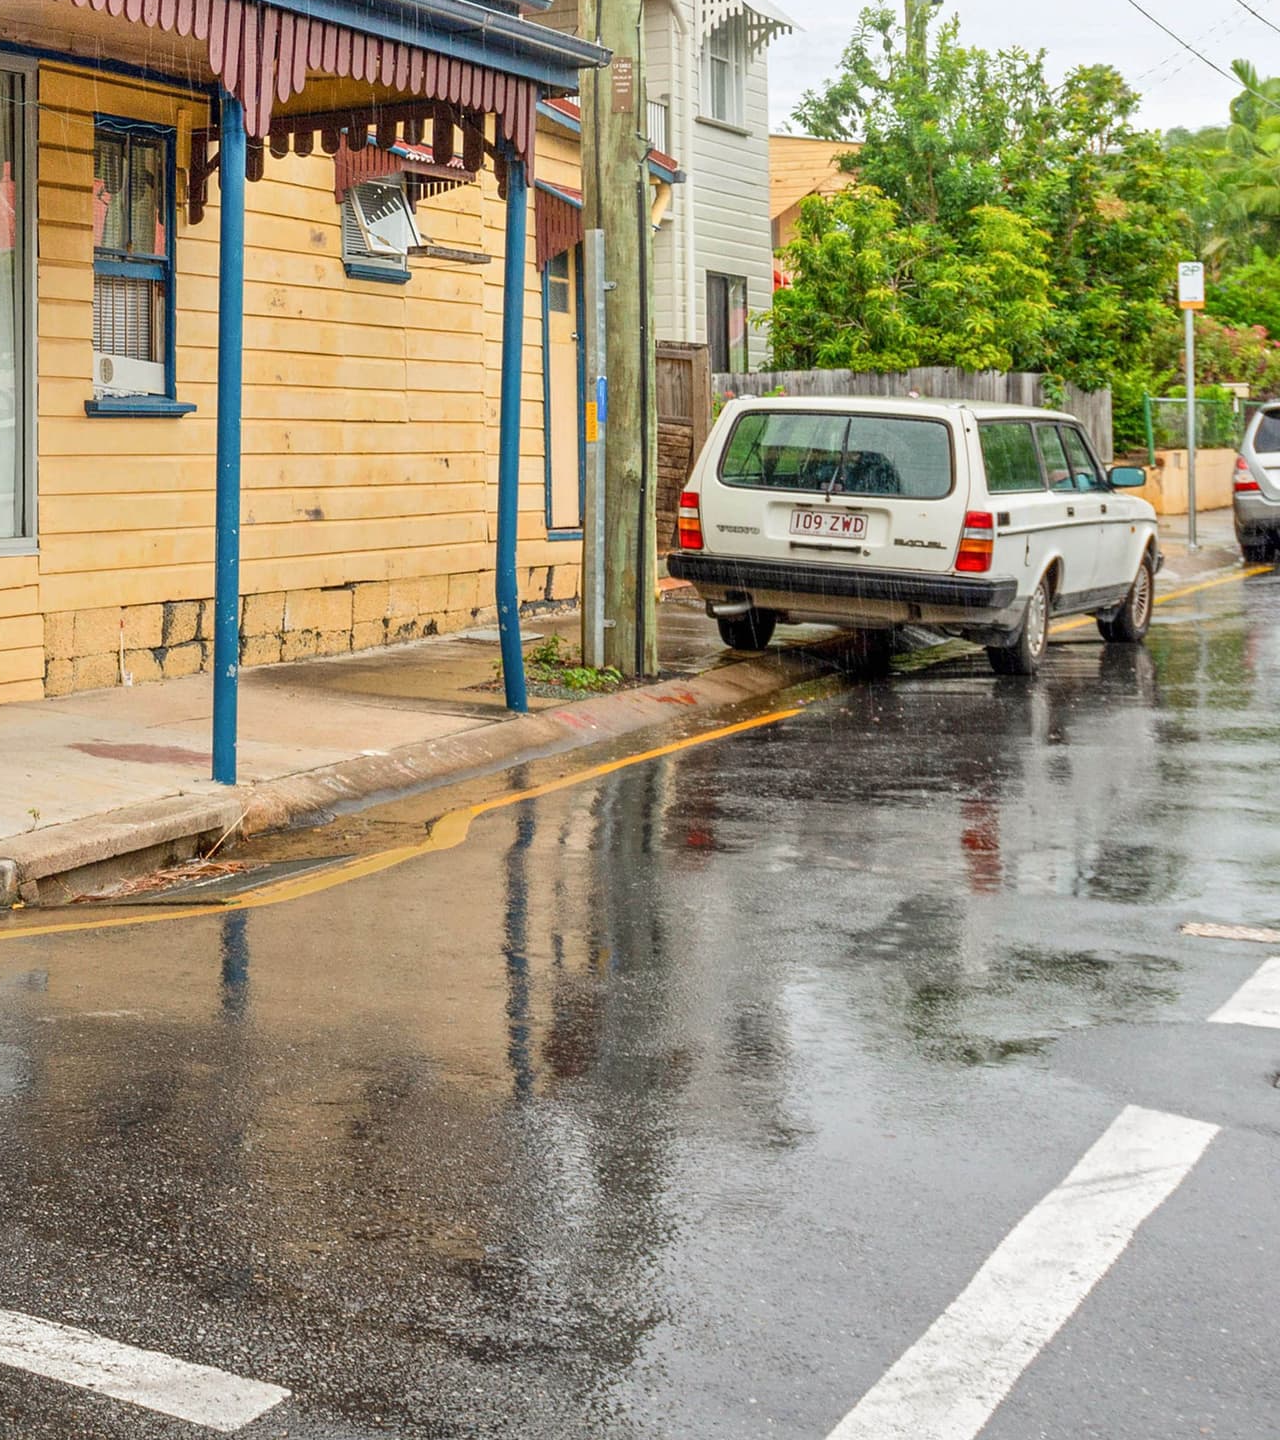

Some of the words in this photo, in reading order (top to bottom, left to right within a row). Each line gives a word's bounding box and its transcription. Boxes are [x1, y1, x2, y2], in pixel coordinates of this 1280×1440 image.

[1182, 265, 1201, 276] 2P
[795, 513, 823, 530] 109
[829, 515, 865, 533] ZWD
